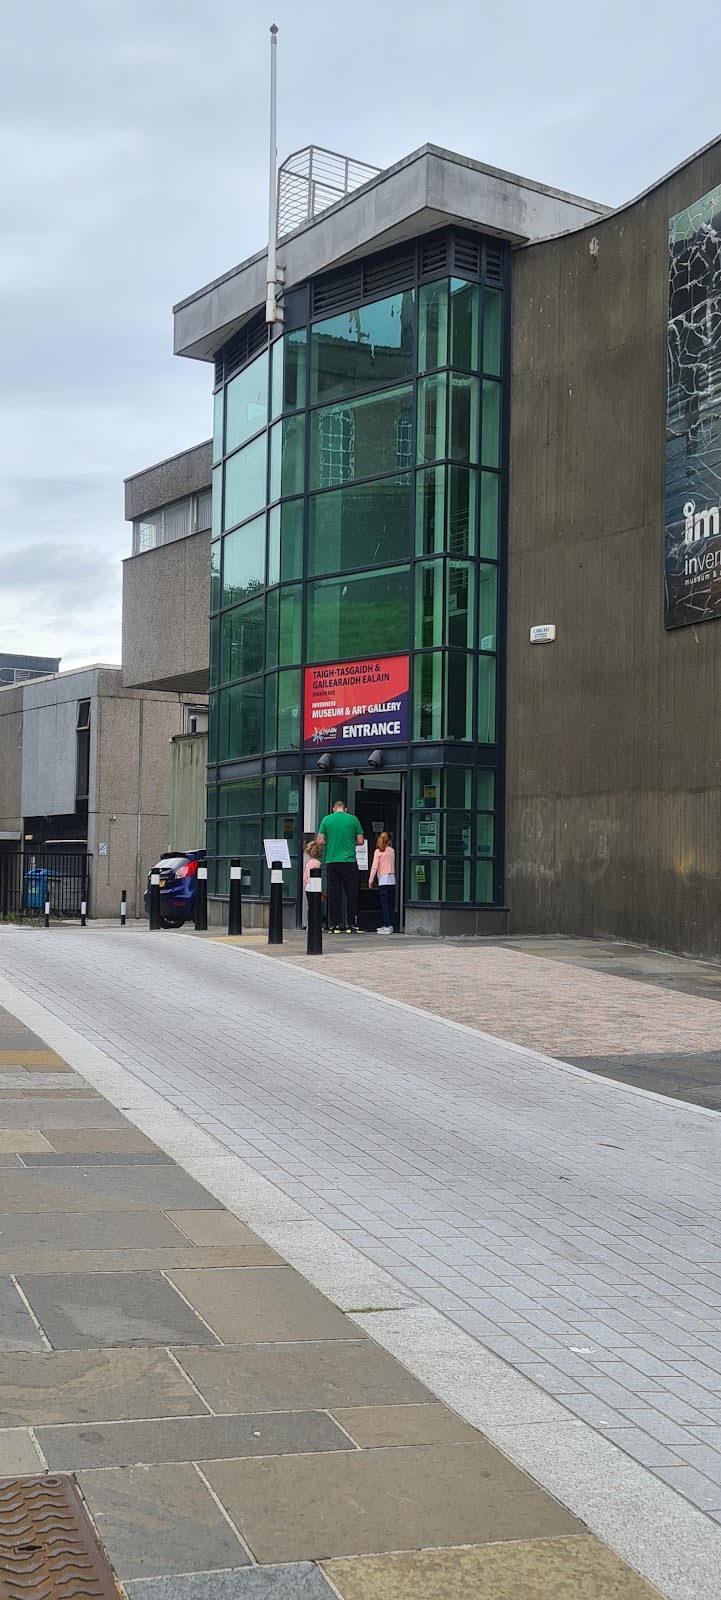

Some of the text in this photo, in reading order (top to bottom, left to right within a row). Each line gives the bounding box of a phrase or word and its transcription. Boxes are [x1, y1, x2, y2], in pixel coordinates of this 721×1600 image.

[684, 550, 721, 576] inver
[684, 573, 711, 586] museum
[313, 664, 381, 679] TAIGH-TASGAIDH &
[312, 673, 390, 689] GAILEARAIDH EALAIN
[312, 700, 337, 708] INVERNESS
[312, 702, 402, 718] MUSEUM & ART GALLERY
[342, 721, 401, 739] ENTRANCE
